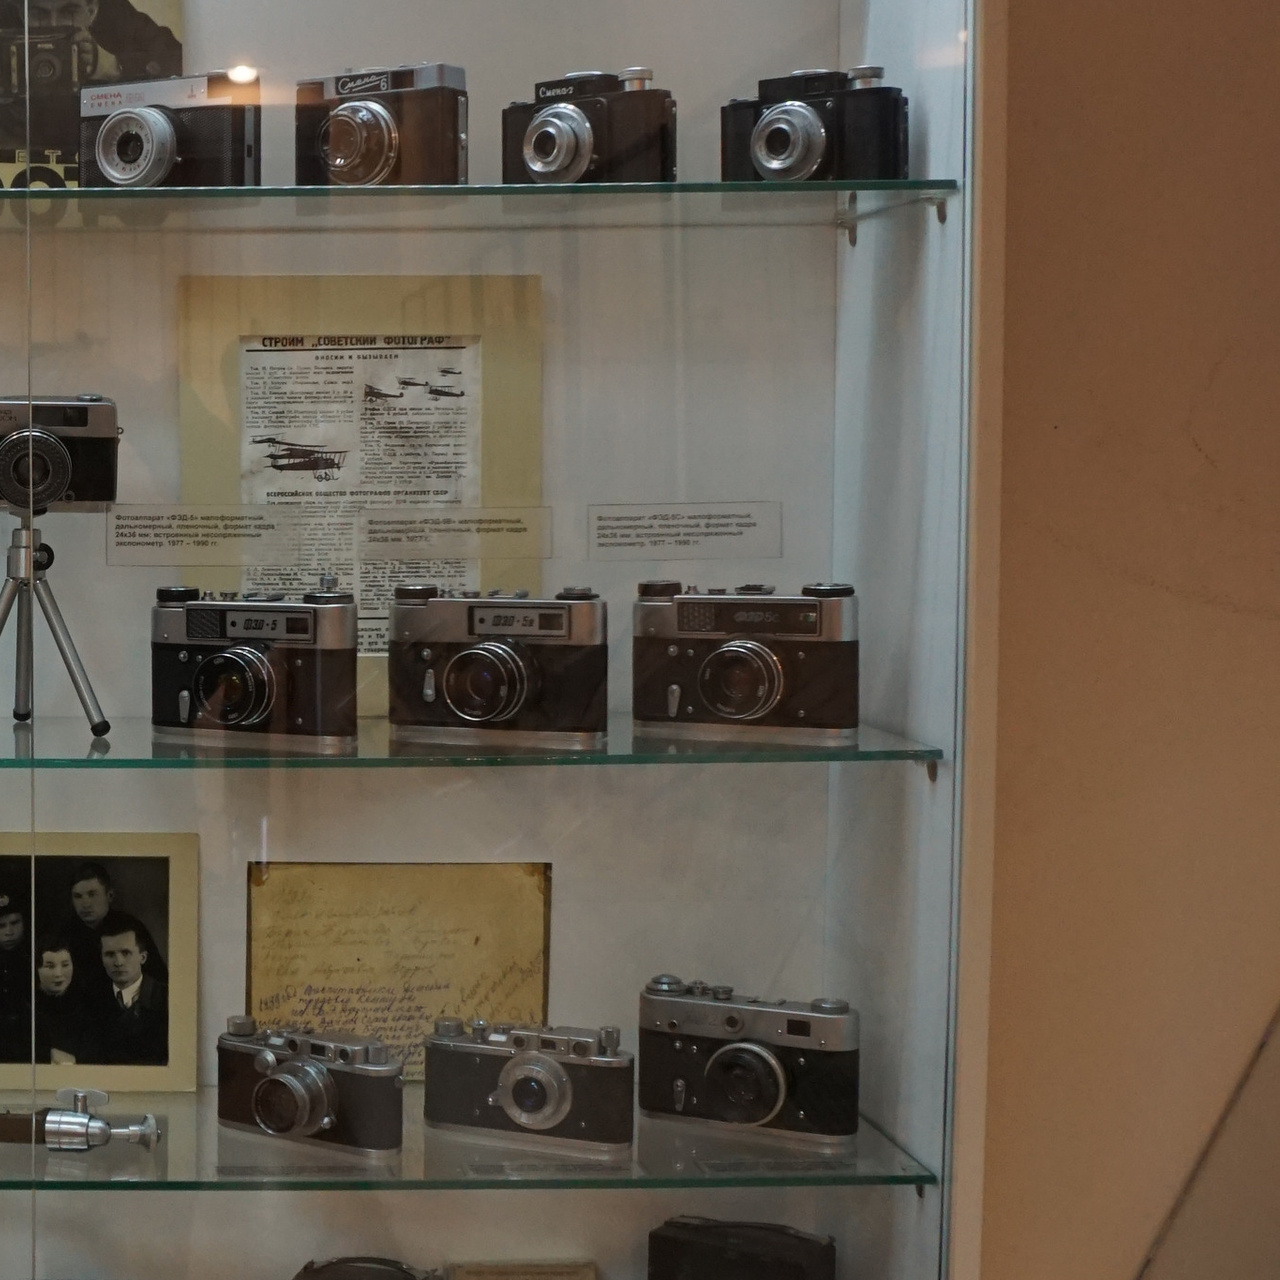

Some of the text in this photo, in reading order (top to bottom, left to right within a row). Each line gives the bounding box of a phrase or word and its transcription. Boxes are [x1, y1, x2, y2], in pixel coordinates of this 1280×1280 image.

[338, 74, 387, 92] Смена 6
[91, 92, 121, 101] СМЕНА
[262, 337, 304, 347] СТРОИМ
[267, 489, 448, 498] ВСЕРОССИЙСКОЕ ОБЩЕСТВО ФОТОГРАФОВ ОРГАНИЗУЕТ СБОР
[115, 514, 164, 522] Фотоаппарат
